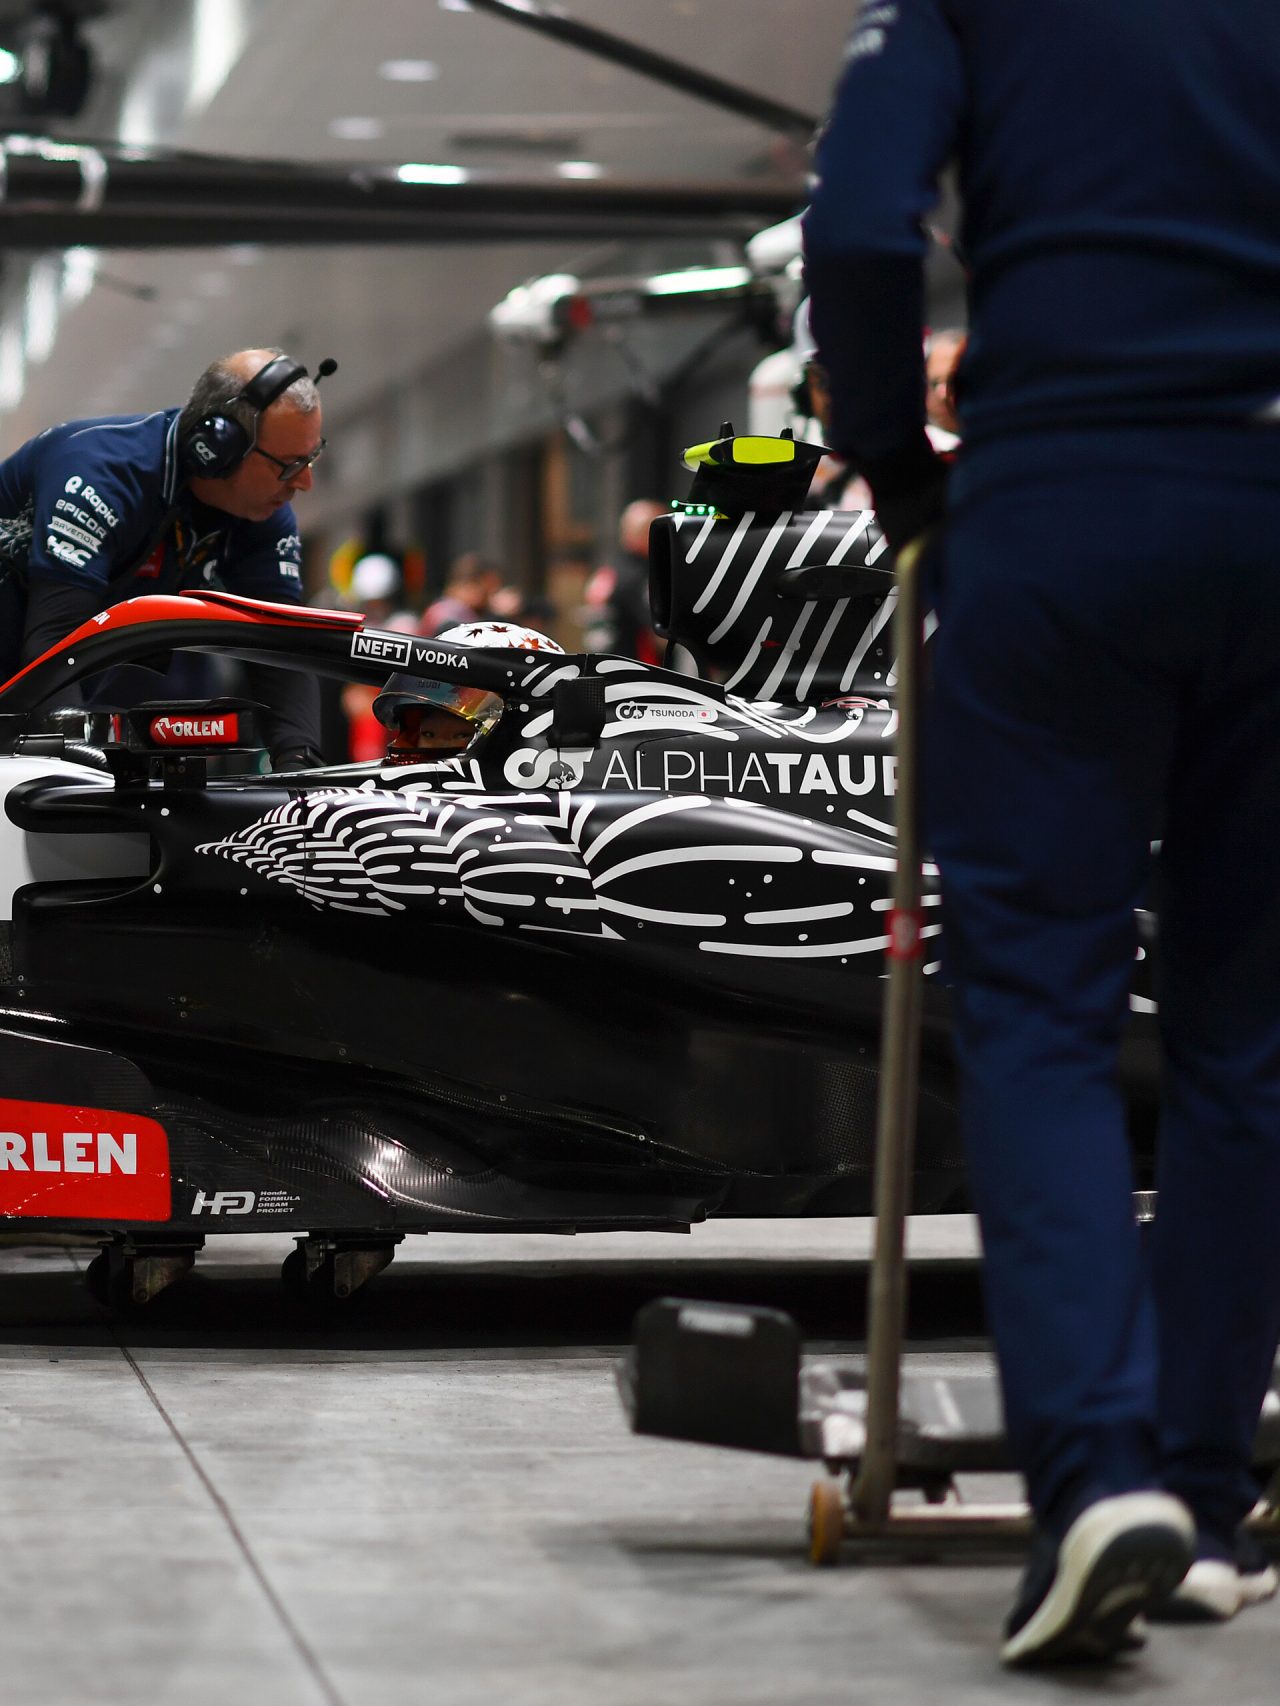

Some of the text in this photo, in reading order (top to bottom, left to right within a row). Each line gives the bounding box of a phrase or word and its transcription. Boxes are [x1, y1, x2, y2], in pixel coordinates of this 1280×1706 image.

[81, 485, 119, 528] Rapid
[357, 638, 469, 669] NEFT VODKA
[650, 709, 695, 718] TSUNODA
[172, 720, 225, 737] ORLEN
